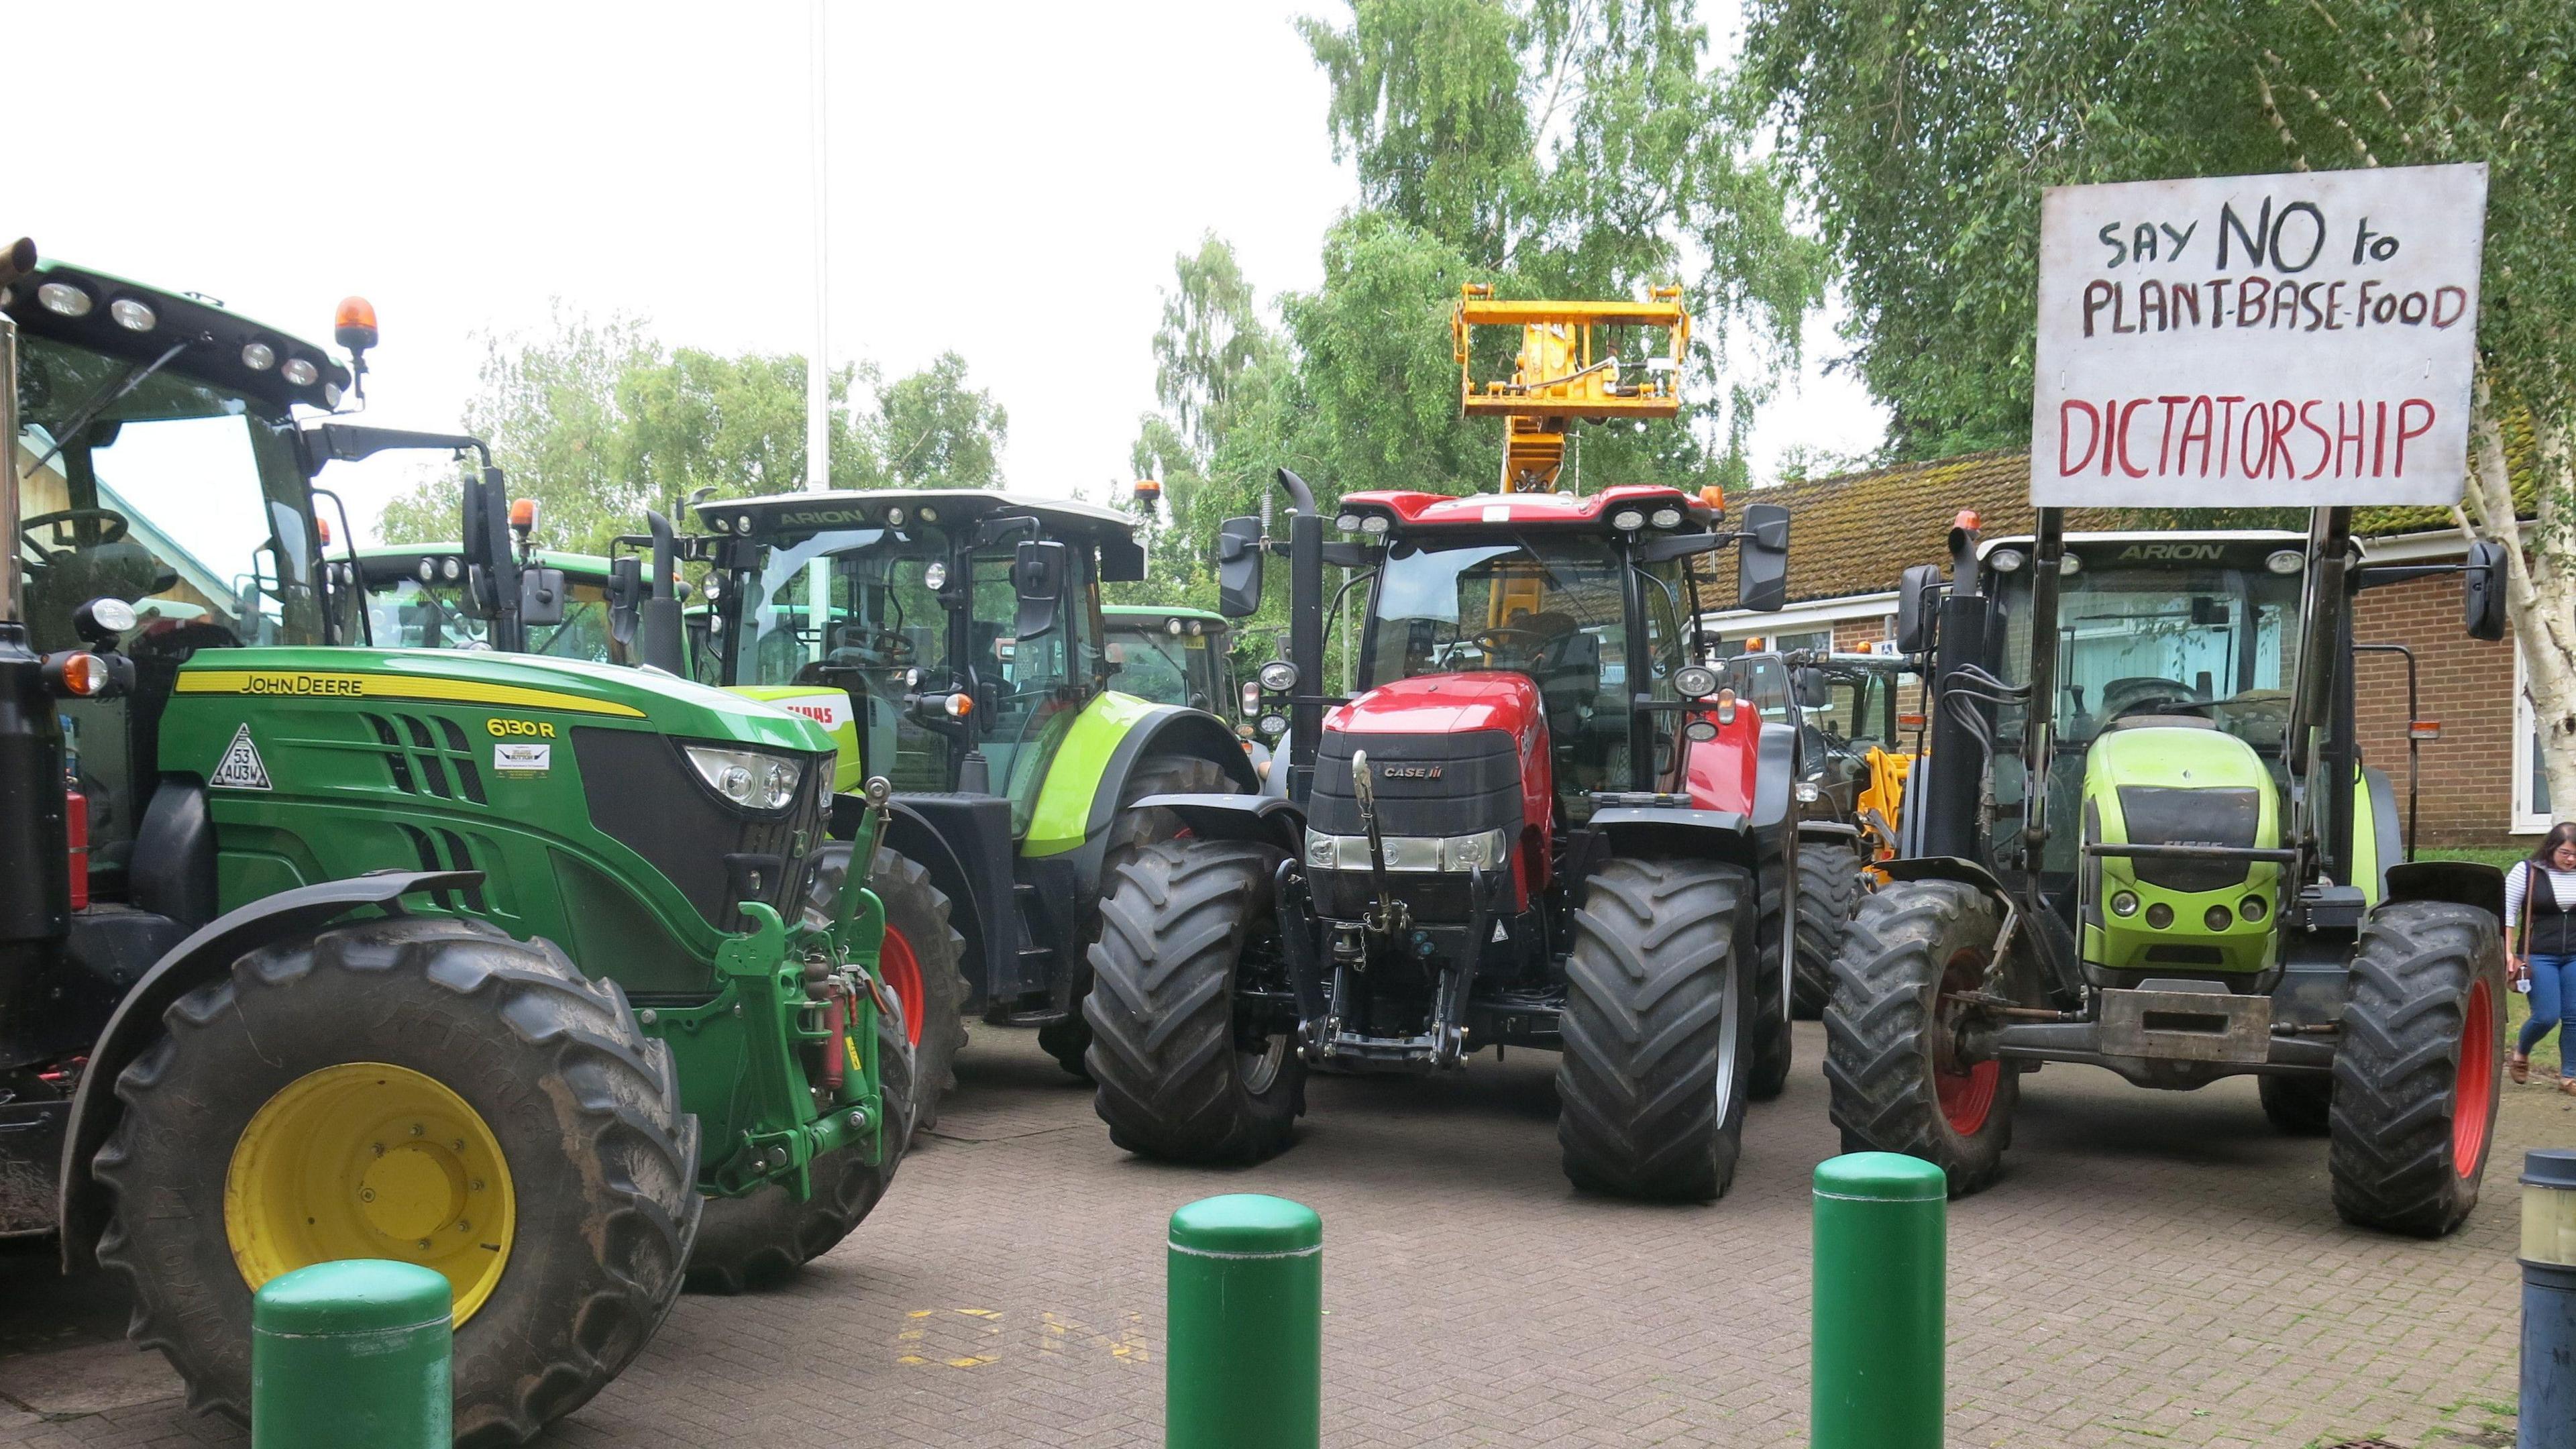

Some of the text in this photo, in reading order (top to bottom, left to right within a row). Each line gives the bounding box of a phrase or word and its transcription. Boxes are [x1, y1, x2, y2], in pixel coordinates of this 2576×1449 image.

[2098, 220, 2199, 268] SAY
[2216, 195, 2326, 273] NO
[2058, 394, 2436, 481] DICTATORSHIP
[781, 510, 865, 525] ARION
[2117, 544, 2225, 560] ARION
[241, 675, 364, 694] JOHN DEERE
[233, 749, 250, 764] 53
[1384, 767, 1426, 777] CASE
